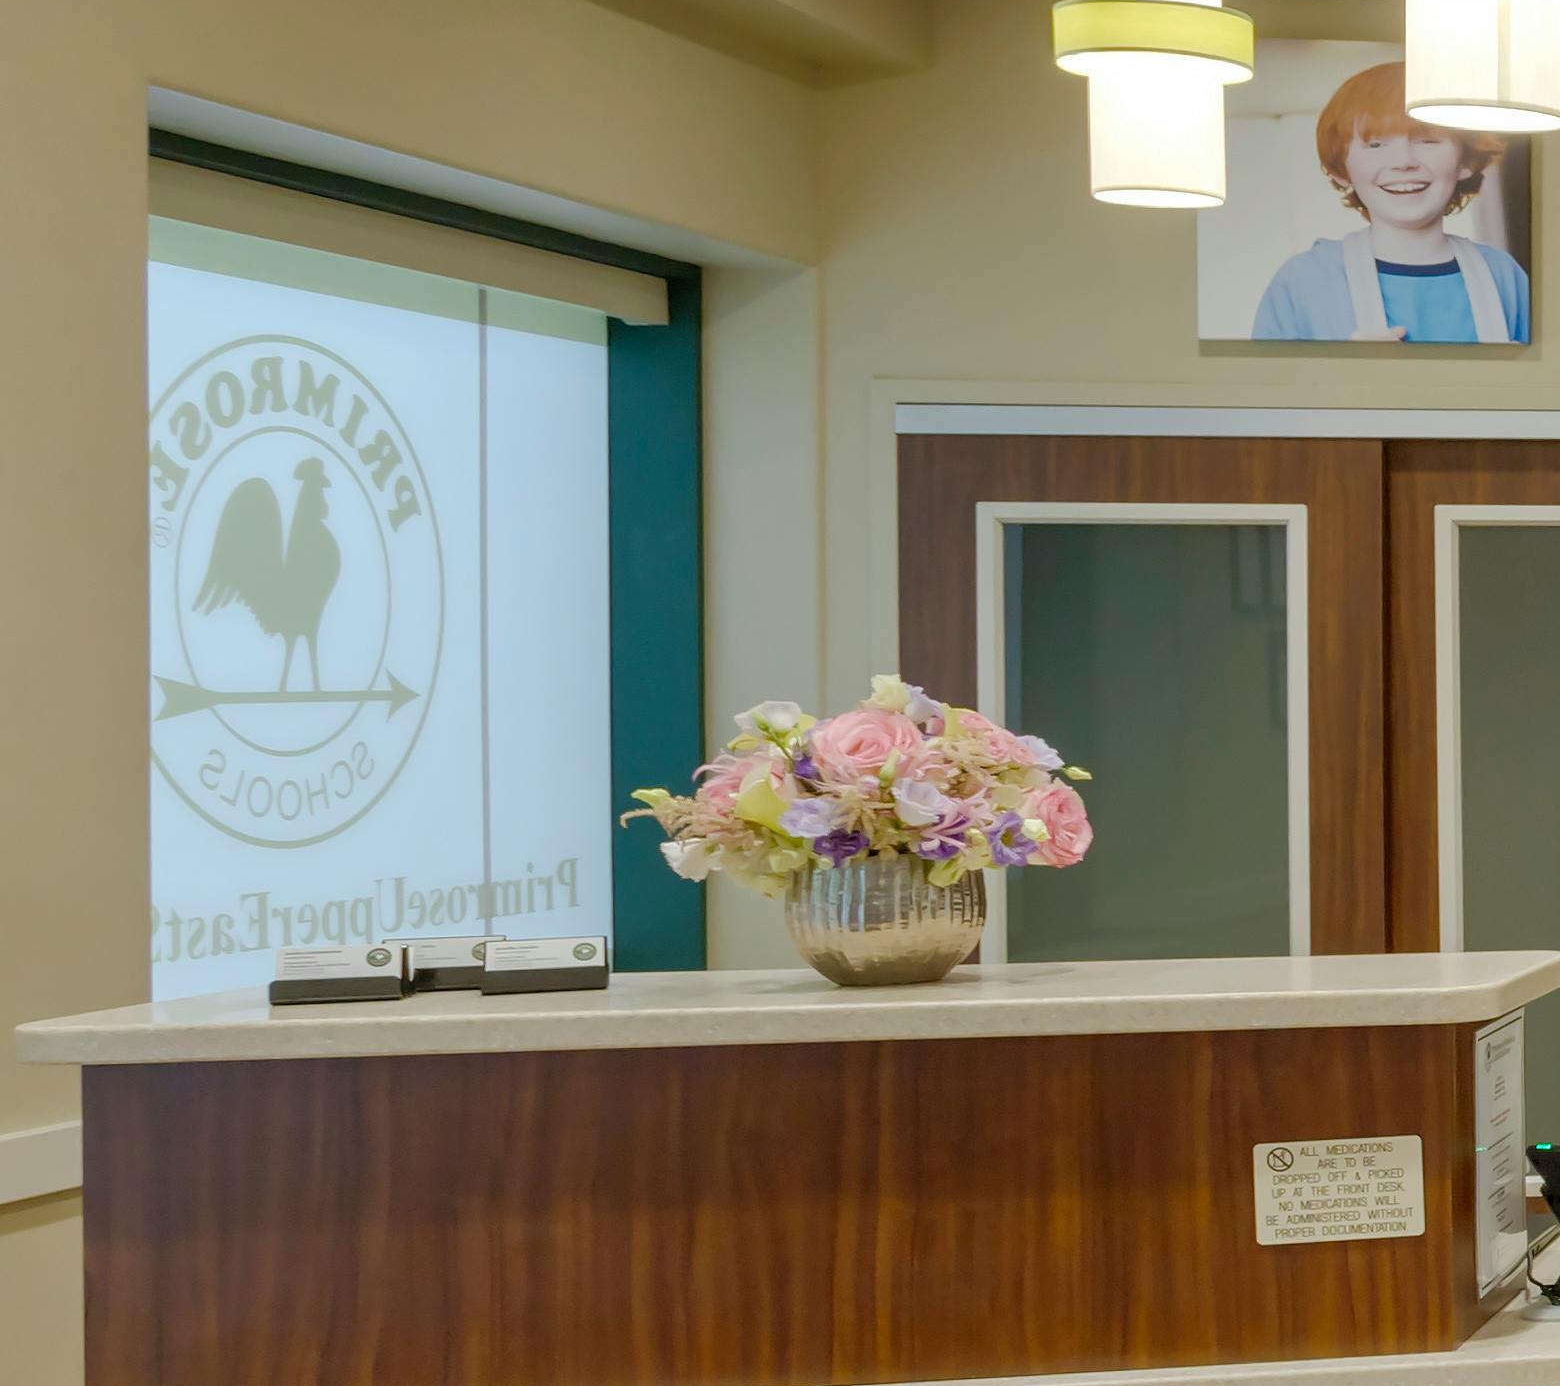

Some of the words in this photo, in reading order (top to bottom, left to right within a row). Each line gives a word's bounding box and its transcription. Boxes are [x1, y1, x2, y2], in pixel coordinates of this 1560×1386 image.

[1300, 1145, 1320, 1157] ALL
[1326, 1141, 1394, 1156] MEDICATIONS
[1317, 1158, 1337, 1169] ARE
[1344, 1157, 1357, 1168] TO
[1362, 1155, 1376, 1167] BE
[1272, 1172, 1321, 1186] DROPPED
[1328, 1170, 1347, 1182] OFF
[1368, 1167, 1405, 1180] PICKED
[1271, 1188, 1286, 1199] UP
[1292, 1187, 1303, 1197] AT
[1311, 1185, 1330, 1197] THE
[1337, 1183, 1370, 1194] FRONT
[1377, 1180, 1406, 1192] DESK
[1278, 1200, 1294, 1212] NO
[1300, 1196, 1368, 1211] MEDICATIONS
[1374, 1195, 1400, 1206] WILL
[1265, 1214, 1280, 1226] BE
[1286, 1210, 1361, 1225] ADMINISTERED
[1367, 1206, 1414, 1220] WITHOUT
[1274, 1226, 1316, 1239] PROPER
[1321, 1221, 1408, 1237] DOCUMENTATION
